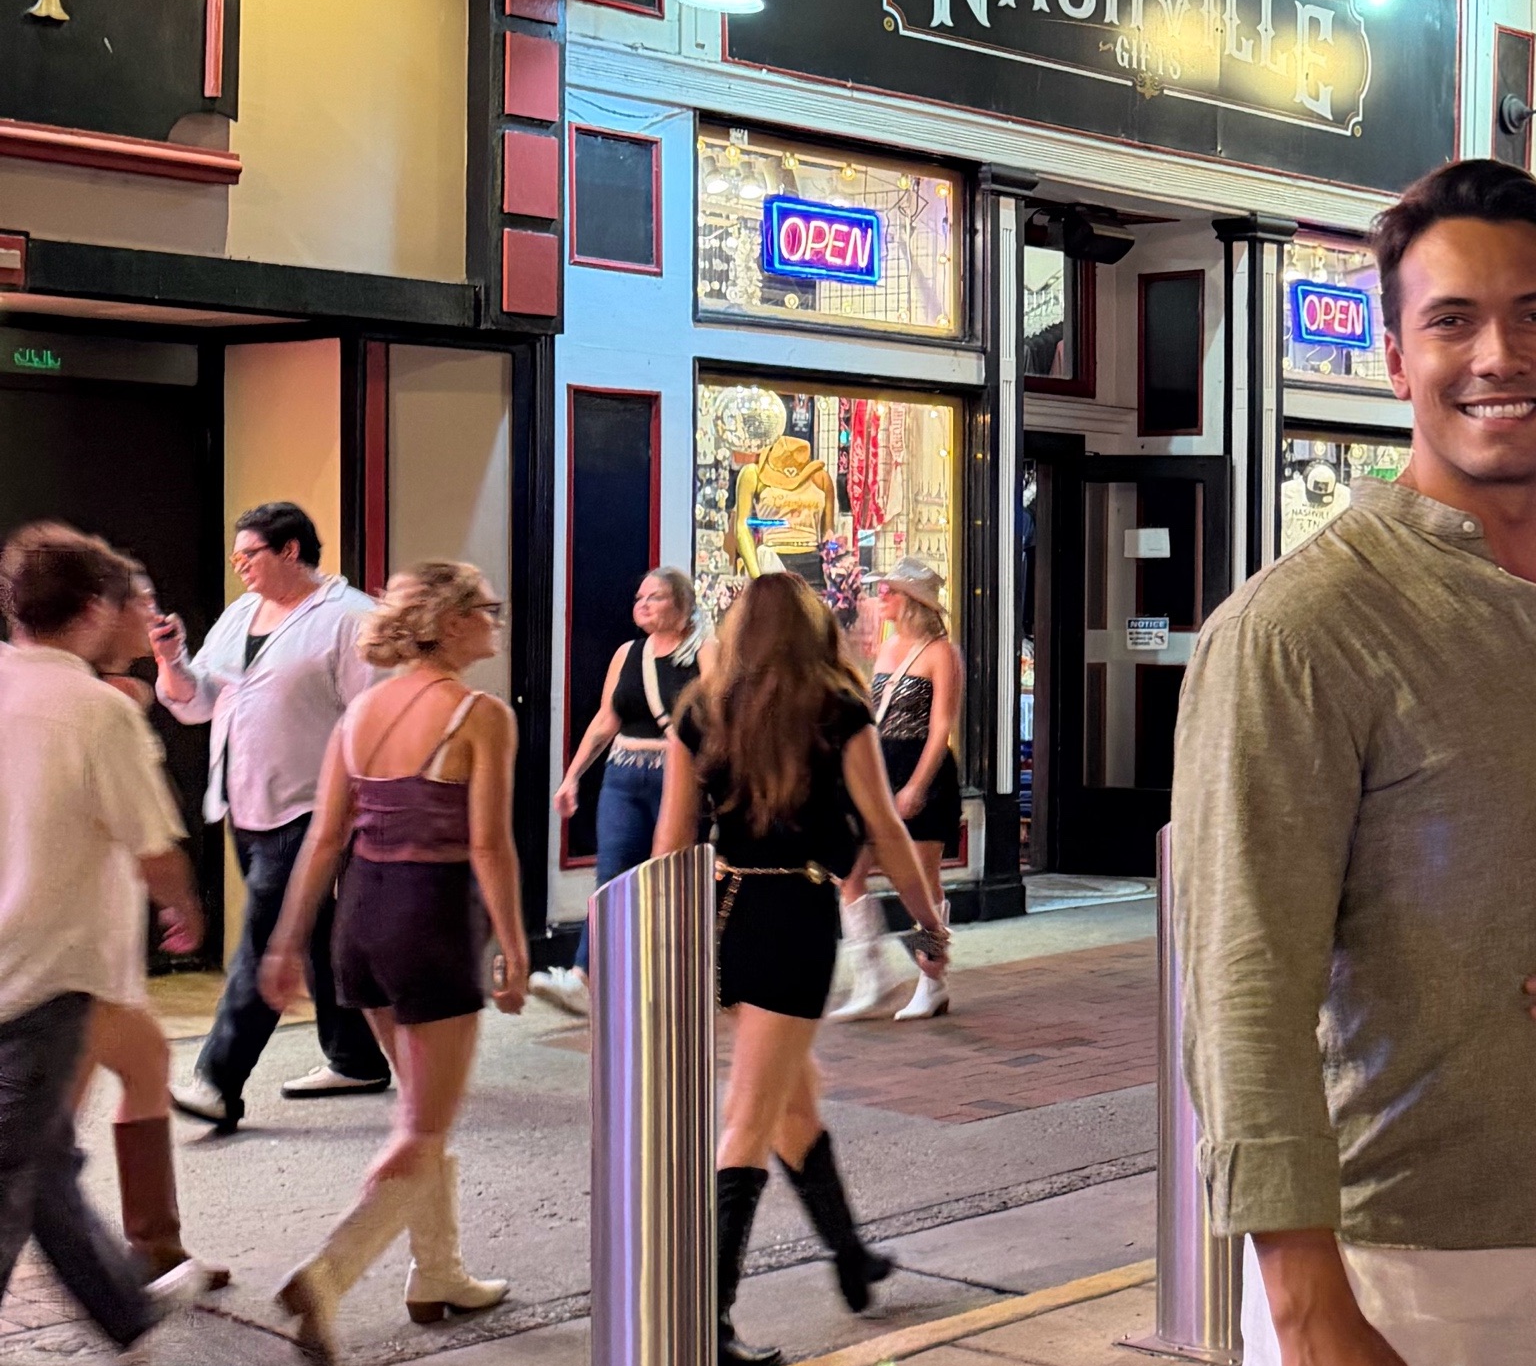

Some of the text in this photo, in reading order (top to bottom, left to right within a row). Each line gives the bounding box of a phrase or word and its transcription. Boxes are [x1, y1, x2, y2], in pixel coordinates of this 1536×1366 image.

[1114, 33, 1182, 80] GIFTS
[780, 217, 872, 268] OPEN
[1303, 294, 1363, 336] OPEN
[1130, 620, 1166, 628] NOTICE
